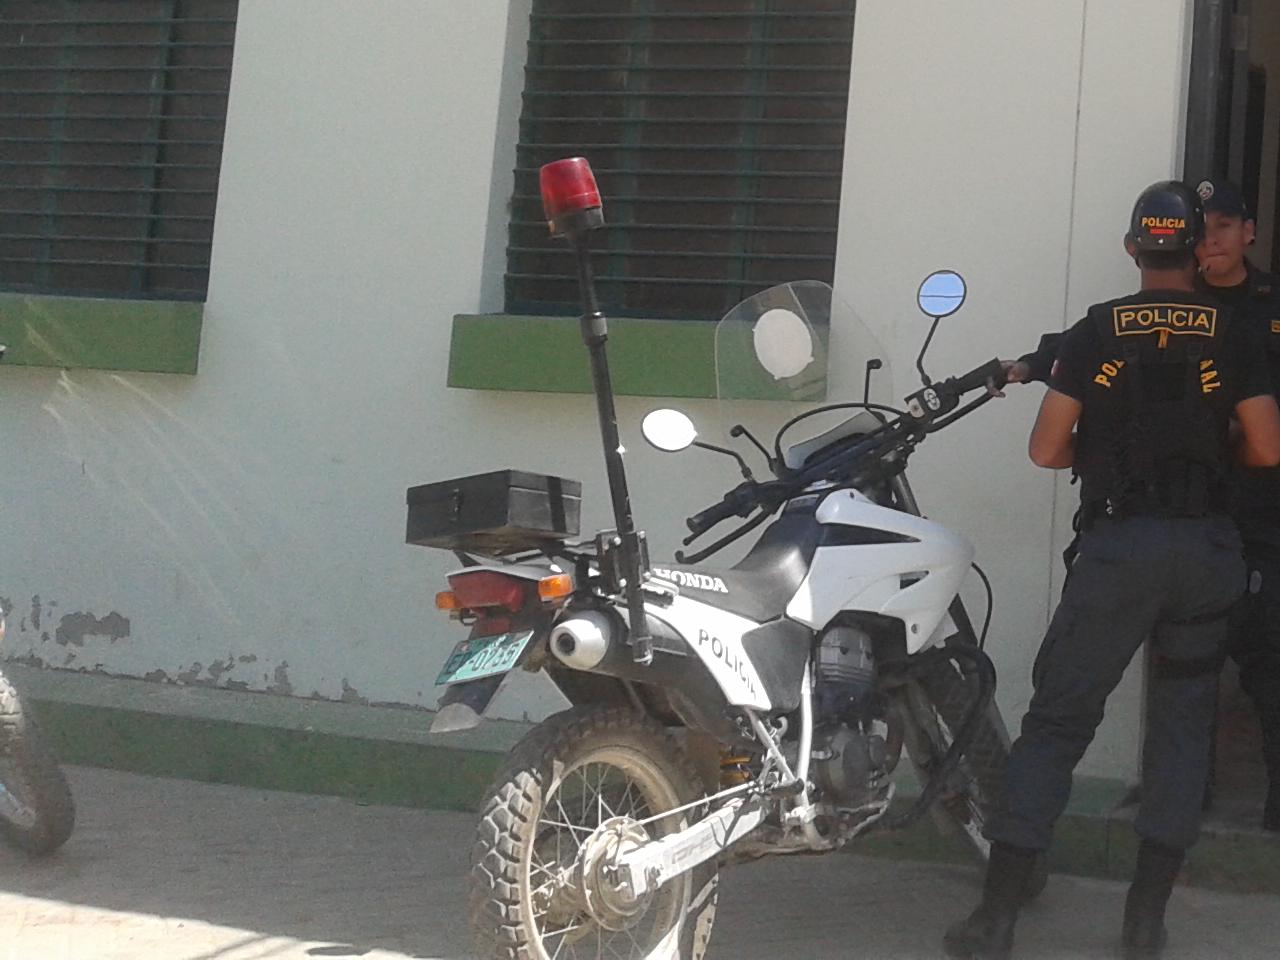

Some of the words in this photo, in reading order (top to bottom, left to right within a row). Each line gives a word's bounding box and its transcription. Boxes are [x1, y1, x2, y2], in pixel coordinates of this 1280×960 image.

[1140, 216, 1186, 229] POLICIA
[1120, 309, 1210, 328] POLICIA
[653, 567, 729, 594] HONDA
[698, 628, 757, 701] POLICIA
